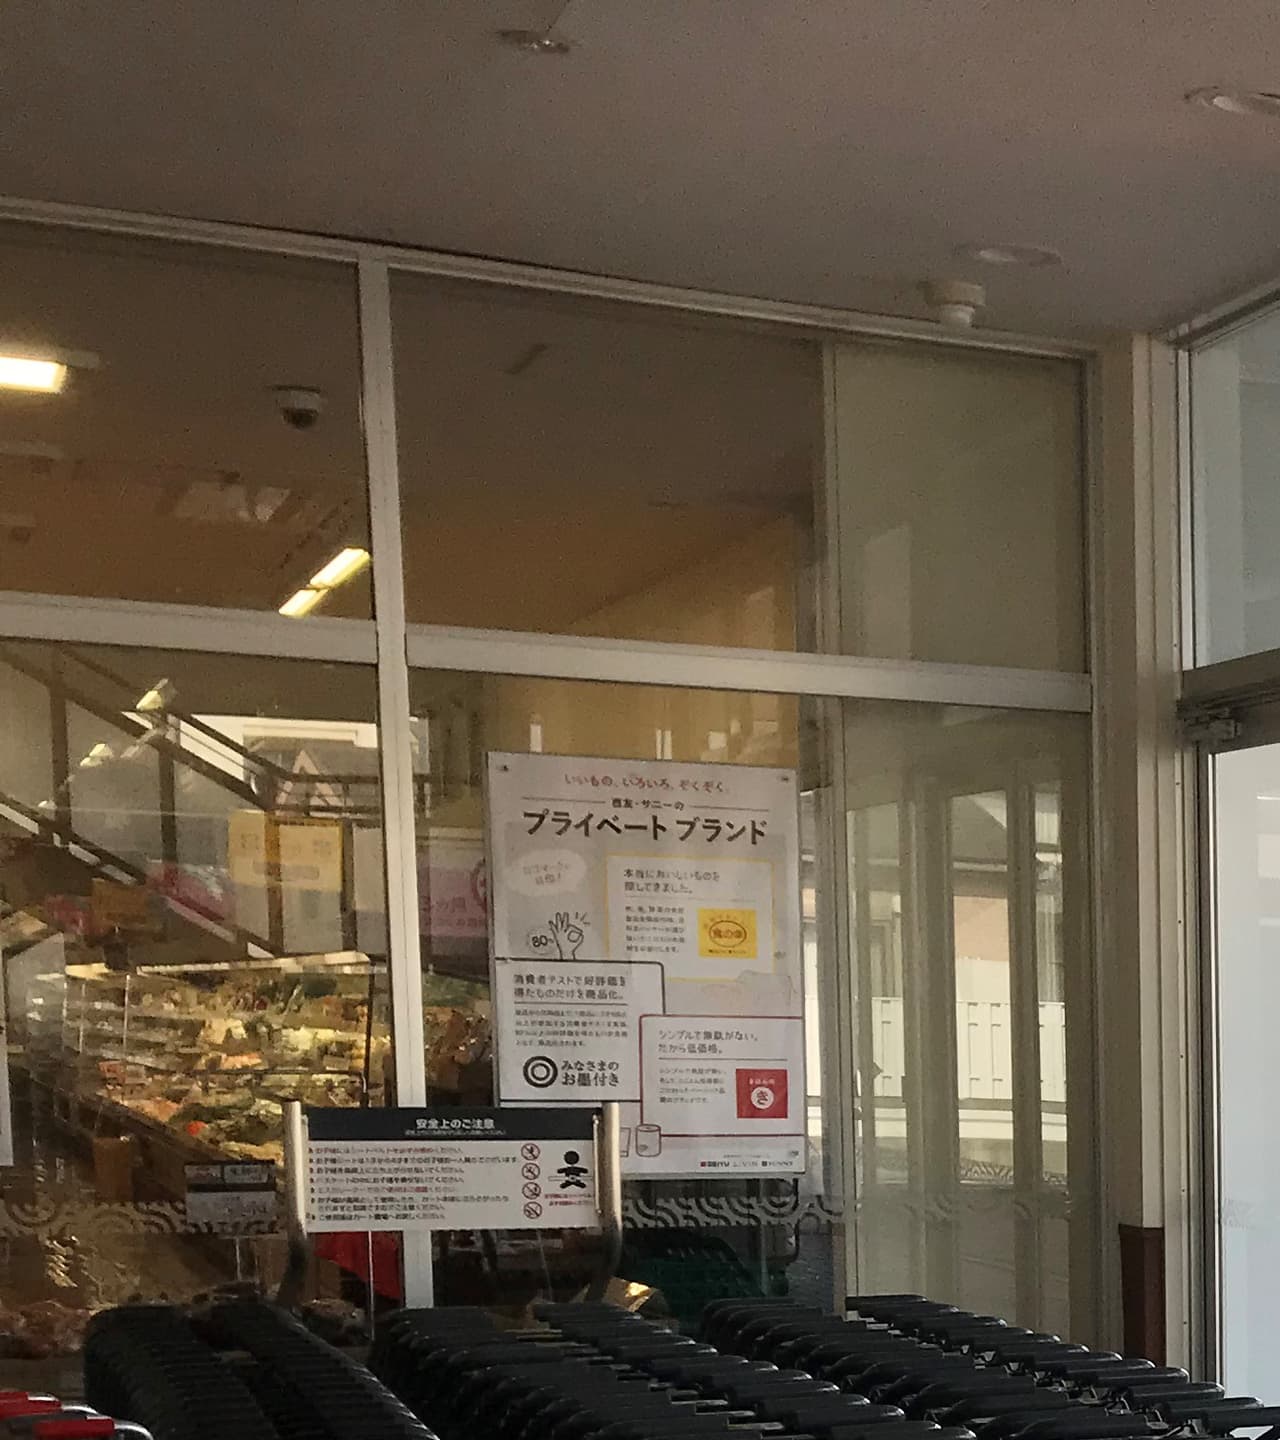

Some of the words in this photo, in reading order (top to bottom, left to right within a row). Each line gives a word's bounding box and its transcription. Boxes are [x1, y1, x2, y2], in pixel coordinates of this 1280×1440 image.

[560, 1060, 619, 1071] みなさまの
[561, 1072, 620, 1087] お墨付き
[415, 1118, 496, 1130] 安全上のご注意
